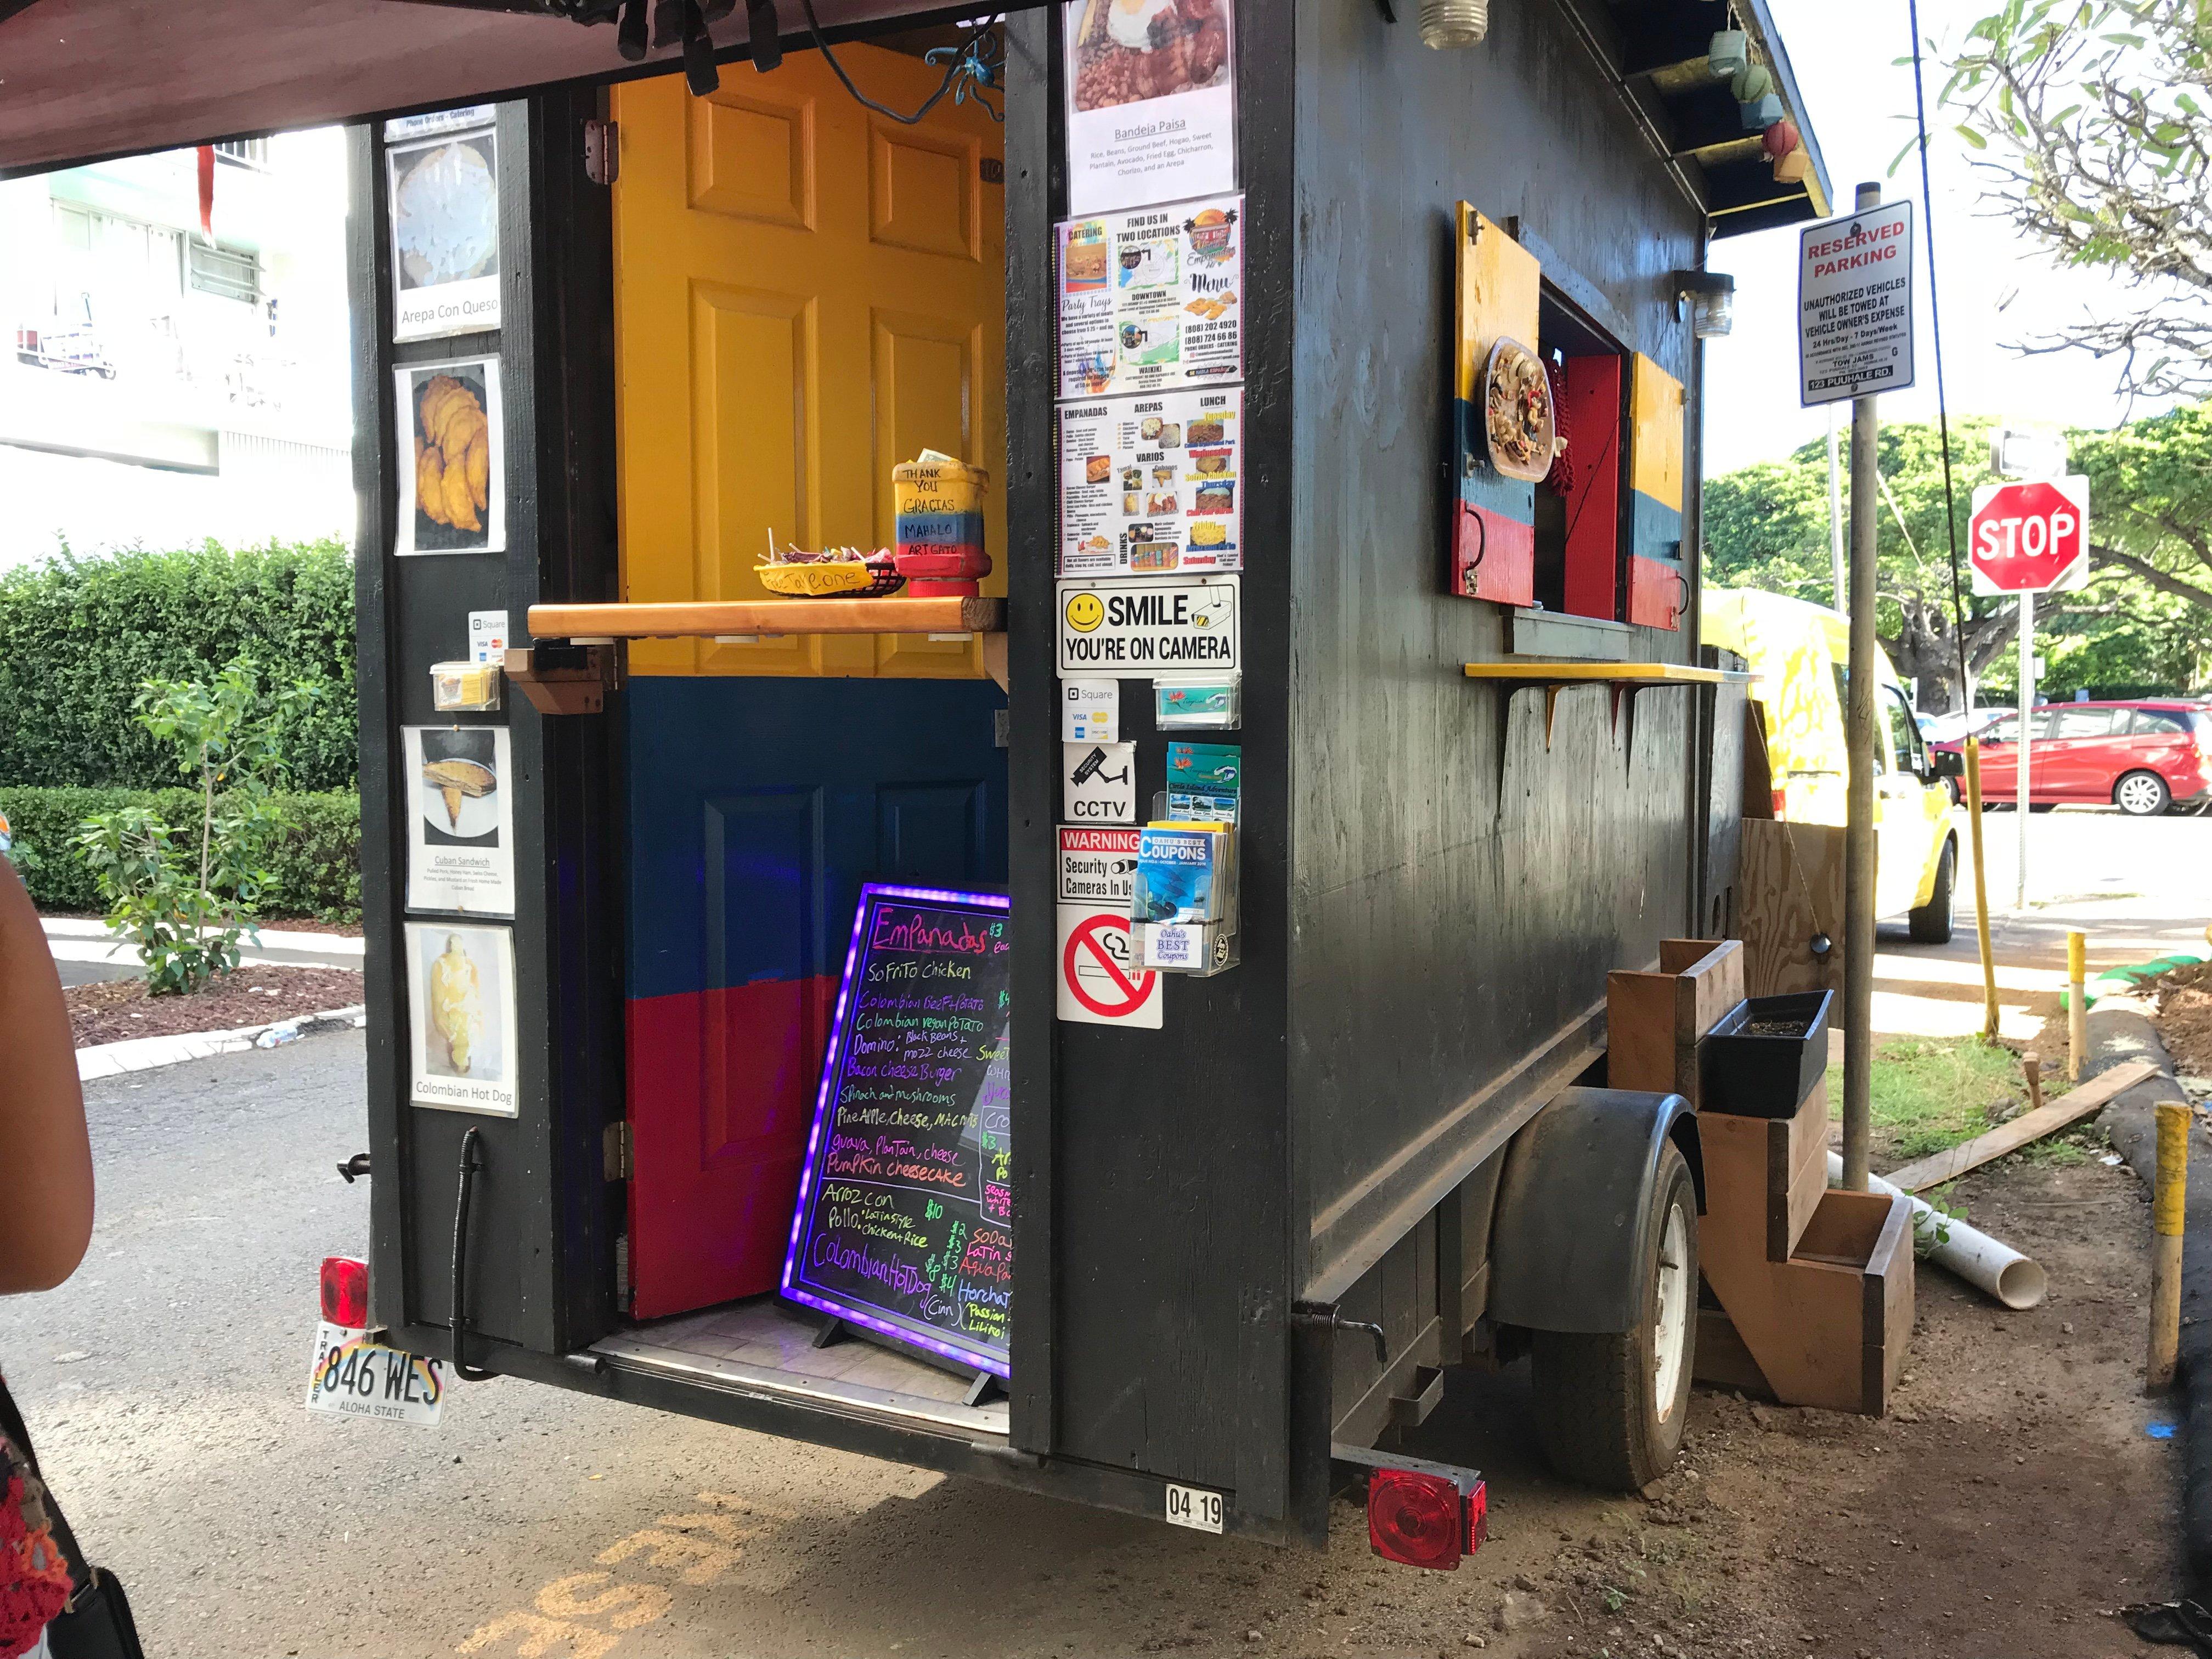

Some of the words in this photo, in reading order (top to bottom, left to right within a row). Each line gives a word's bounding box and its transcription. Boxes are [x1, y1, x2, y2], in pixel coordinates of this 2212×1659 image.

[450, 109, 475, 119] Catering
[1115, 125, 1156, 140] Bandeja
[1159, 119, 1186, 131] Paisa
[1107, 148, 1126, 156] Beans,
[1127, 143, 1150, 153] Ground
[1152, 140, 1167, 149] Beef,
[1169, 136, 1191, 146] Hogao,
[1193, 132, 1212, 141] Sweet
[1090, 160, 1116, 170] Plantain,
[1118, 155, 1145, 166] Avocado,
[1147, 151, 1162, 160] Fried
[1164, 149, 1176, 159] Egg,
[1118, 167, 1142, 176] Chorizo,
[1166, 159, 1184, 168] Arepa
[1127, 217, 1145, 228] FIND
[1147, 215, 1158, 225] US
[1160, 213, 1168, 223] IN
[1068, 227, 1102, 240] CATERING
[1116, 231, 1135, 242] TWO
[1137, 225, 1181, 240] LOCATIONS
[1808, 221, 1905, 260] RESERVED
[1814, 245, 1897, 278] PARKING
[1132, 290, 1166, 301] DOWNTOWN
[1804, 287, 1864, 312] UNAUTHORIZED
[1866, 276, 1906, 297] VEHICLES
[402, 310, 435, 324] Arepa
[438, 304, 459, 318] Con
[462, 298, 498, 314] Queso
[1062, 298, 1087, 314] Party
[1088, 294, 1113, 311] Trays
[1819, 307, 1837, 321] WILL
[1838, 306, 1848, 317] BE
[1850, 298, 1877, 314] TOWED
[1879, 295, 1889, 307] AT
[1185, 324, 1203, 334] (808)
[1205, 322, 1217, 331] 202
[1219, 320, 1237, 329] 4920
[1805, 321, 1836, 338] VEHICLE
[1837, 314, 1870, 332] OWNER'S
[1871, 305, 1905, 323] EXPENSE
[1185, 335, 1203, 345] (808)
[1204, 333, 1216, 342] 724
[1217, 332, 1226, 341] 66
[1813, 340, 1821, 349] 24
[1822, 334, 1849, 346] Hrs/Day
[1860, 324, 1898, 338] Days/Week
[1139, 365, 1162, 374] WAIKIKI
[1833, 358, 1850, 368] TOW
[1827, 370, 1873, 386] PUUHALE
[1875, 368, 1891, 377] RD.
[1135, 402, 1163, 413] AREPAS
[1200, 396, 1226, 407] LUNCH
[1064, 407, 1108, 420] EMPANADAS
[1136, 452, 1164, 462] VARIOS
[902, 469, 941, 479] THANK
[914, 480, 938, 493] YOU
[904, 498, 955, 514] GRACIAS
[905, 523, 952, 538] MAHALO
[1976, 512, 2075, 561] STOP
[1119, 533, 1127, 565] DRINKS
[823, 572, 860, 586] one
[1108, 595, 1188, 627] SMILE
[483, 620, 505, 629] Square
[1066, 637, 1125, 661] YOU'RE
[1130, 637, 1154, 660] ON
[1159, 636, 1231, 660] CAMERA
[1081, 689, 1113, 701] Square
[1079, 753, 1097, 773] SECURITY
[1084, 759, 1099, 776] SYSTEM
[1074, 800, 1126, 817] CCTV
[1064, 832, 1140, 850] WARNING
[1140, 836, 1206, 861] COUPONS
[435, 856, 456, 865] Cuban
[458, 857, 490, 866] Sandwich
[1065, 857, 1107, 878] Security
[1066, 878, 1107, 895] Cameras
[1110, 879, 1119, 895] In
[1161, 928, 1186, 938] Oahu's
[1158, 940, 1189, 950] BEST
[1158, 951, 1188, 962] Coupons
[856, 1013, 918, 1031] Colombian
[416, 1081, 469, 1098] Colombian
[471, 1087, 489, 1101] Hot
[493, 1090, 512, 1105] Dog
[924, 1198, 943, 1221] $10
[324, 1346, 377, 1397] 846
[385, 1351, 443, 1405] WES
[339, 1401, 371, 1415] ALOHA
[374, 1405, 405, 1419] STATE
[1170, 1488, 1191, 1517] 04
[1200, 1496, 1221, 1525] 19
